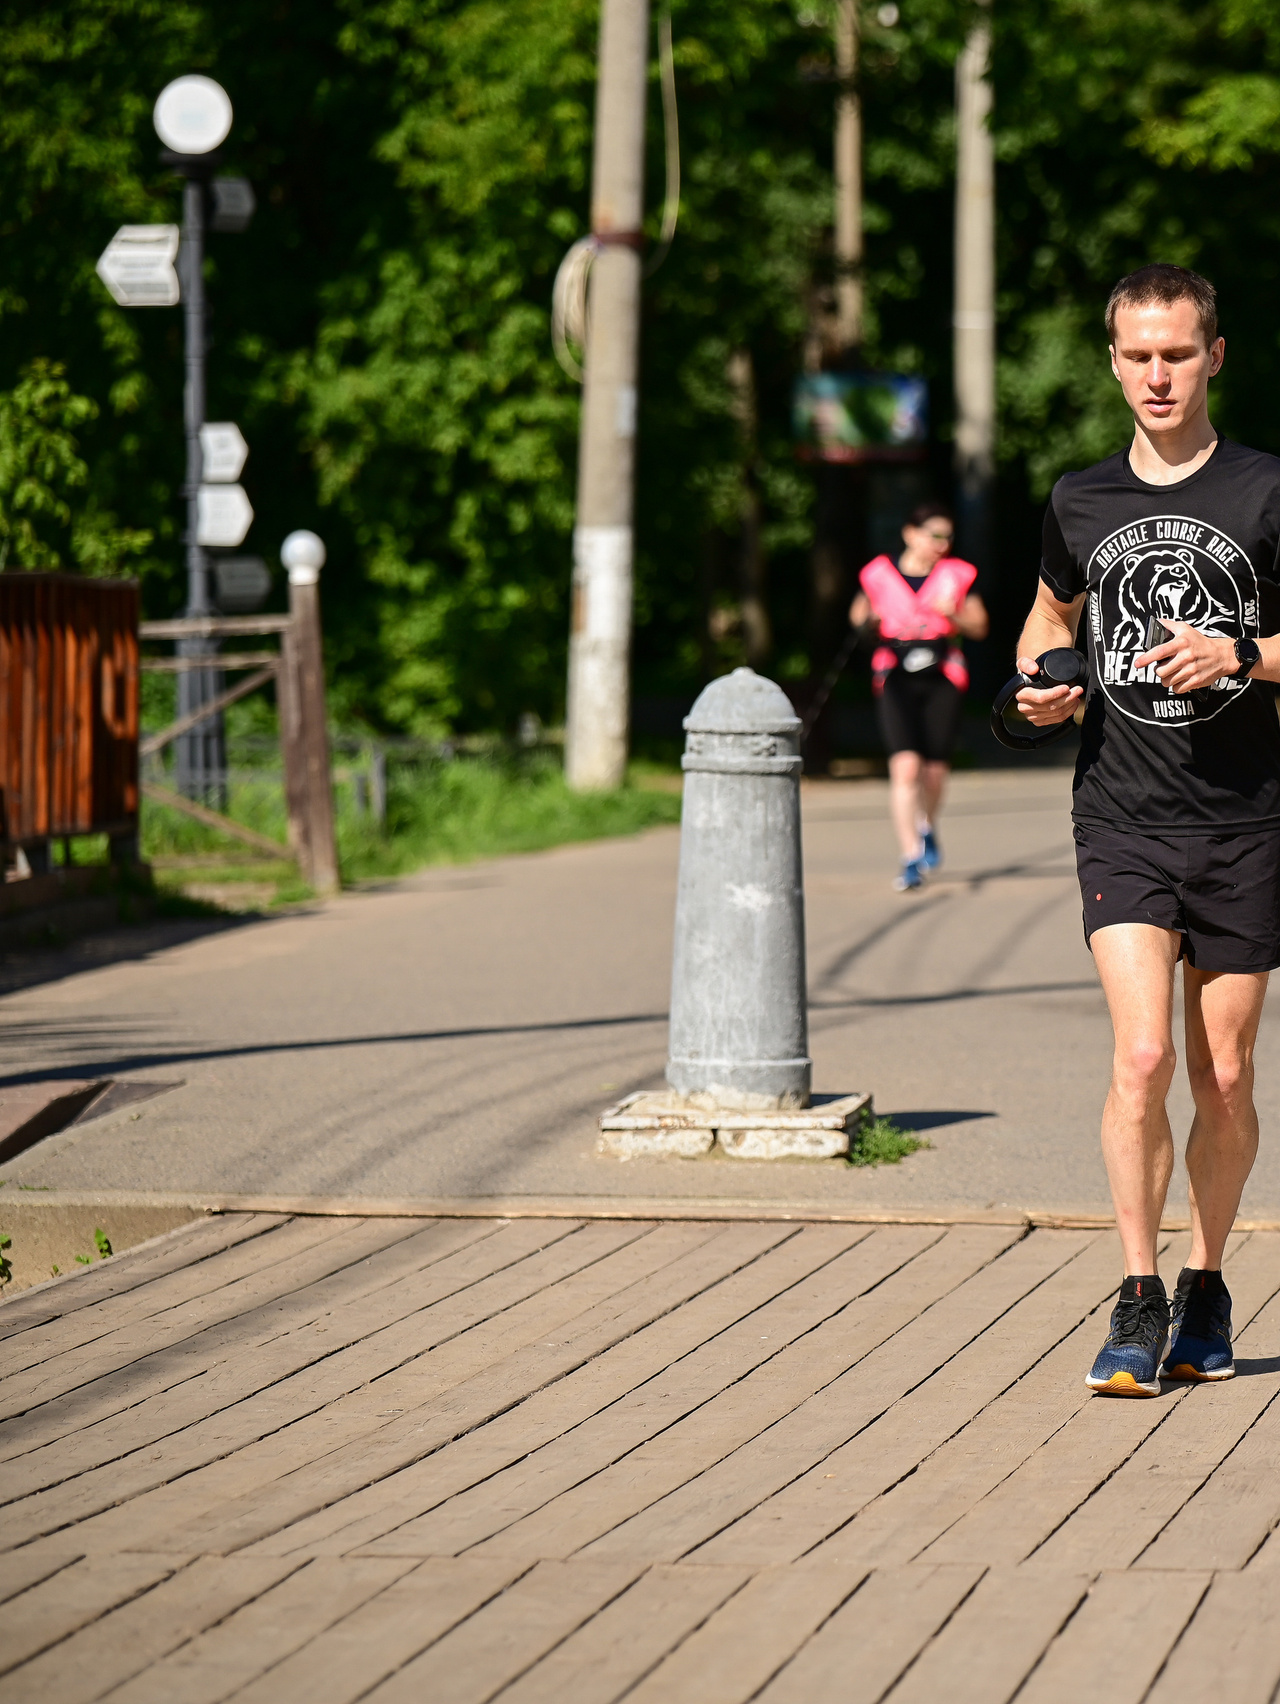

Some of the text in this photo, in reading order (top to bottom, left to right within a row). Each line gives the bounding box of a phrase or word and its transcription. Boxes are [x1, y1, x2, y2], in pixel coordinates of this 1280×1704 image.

[1096, 521, 1240, 569] OBSTACLE COURSE RACE
[1243, 598, 1257, 627] 2017
[1152, 699, 1196, 718] RUSSIA
